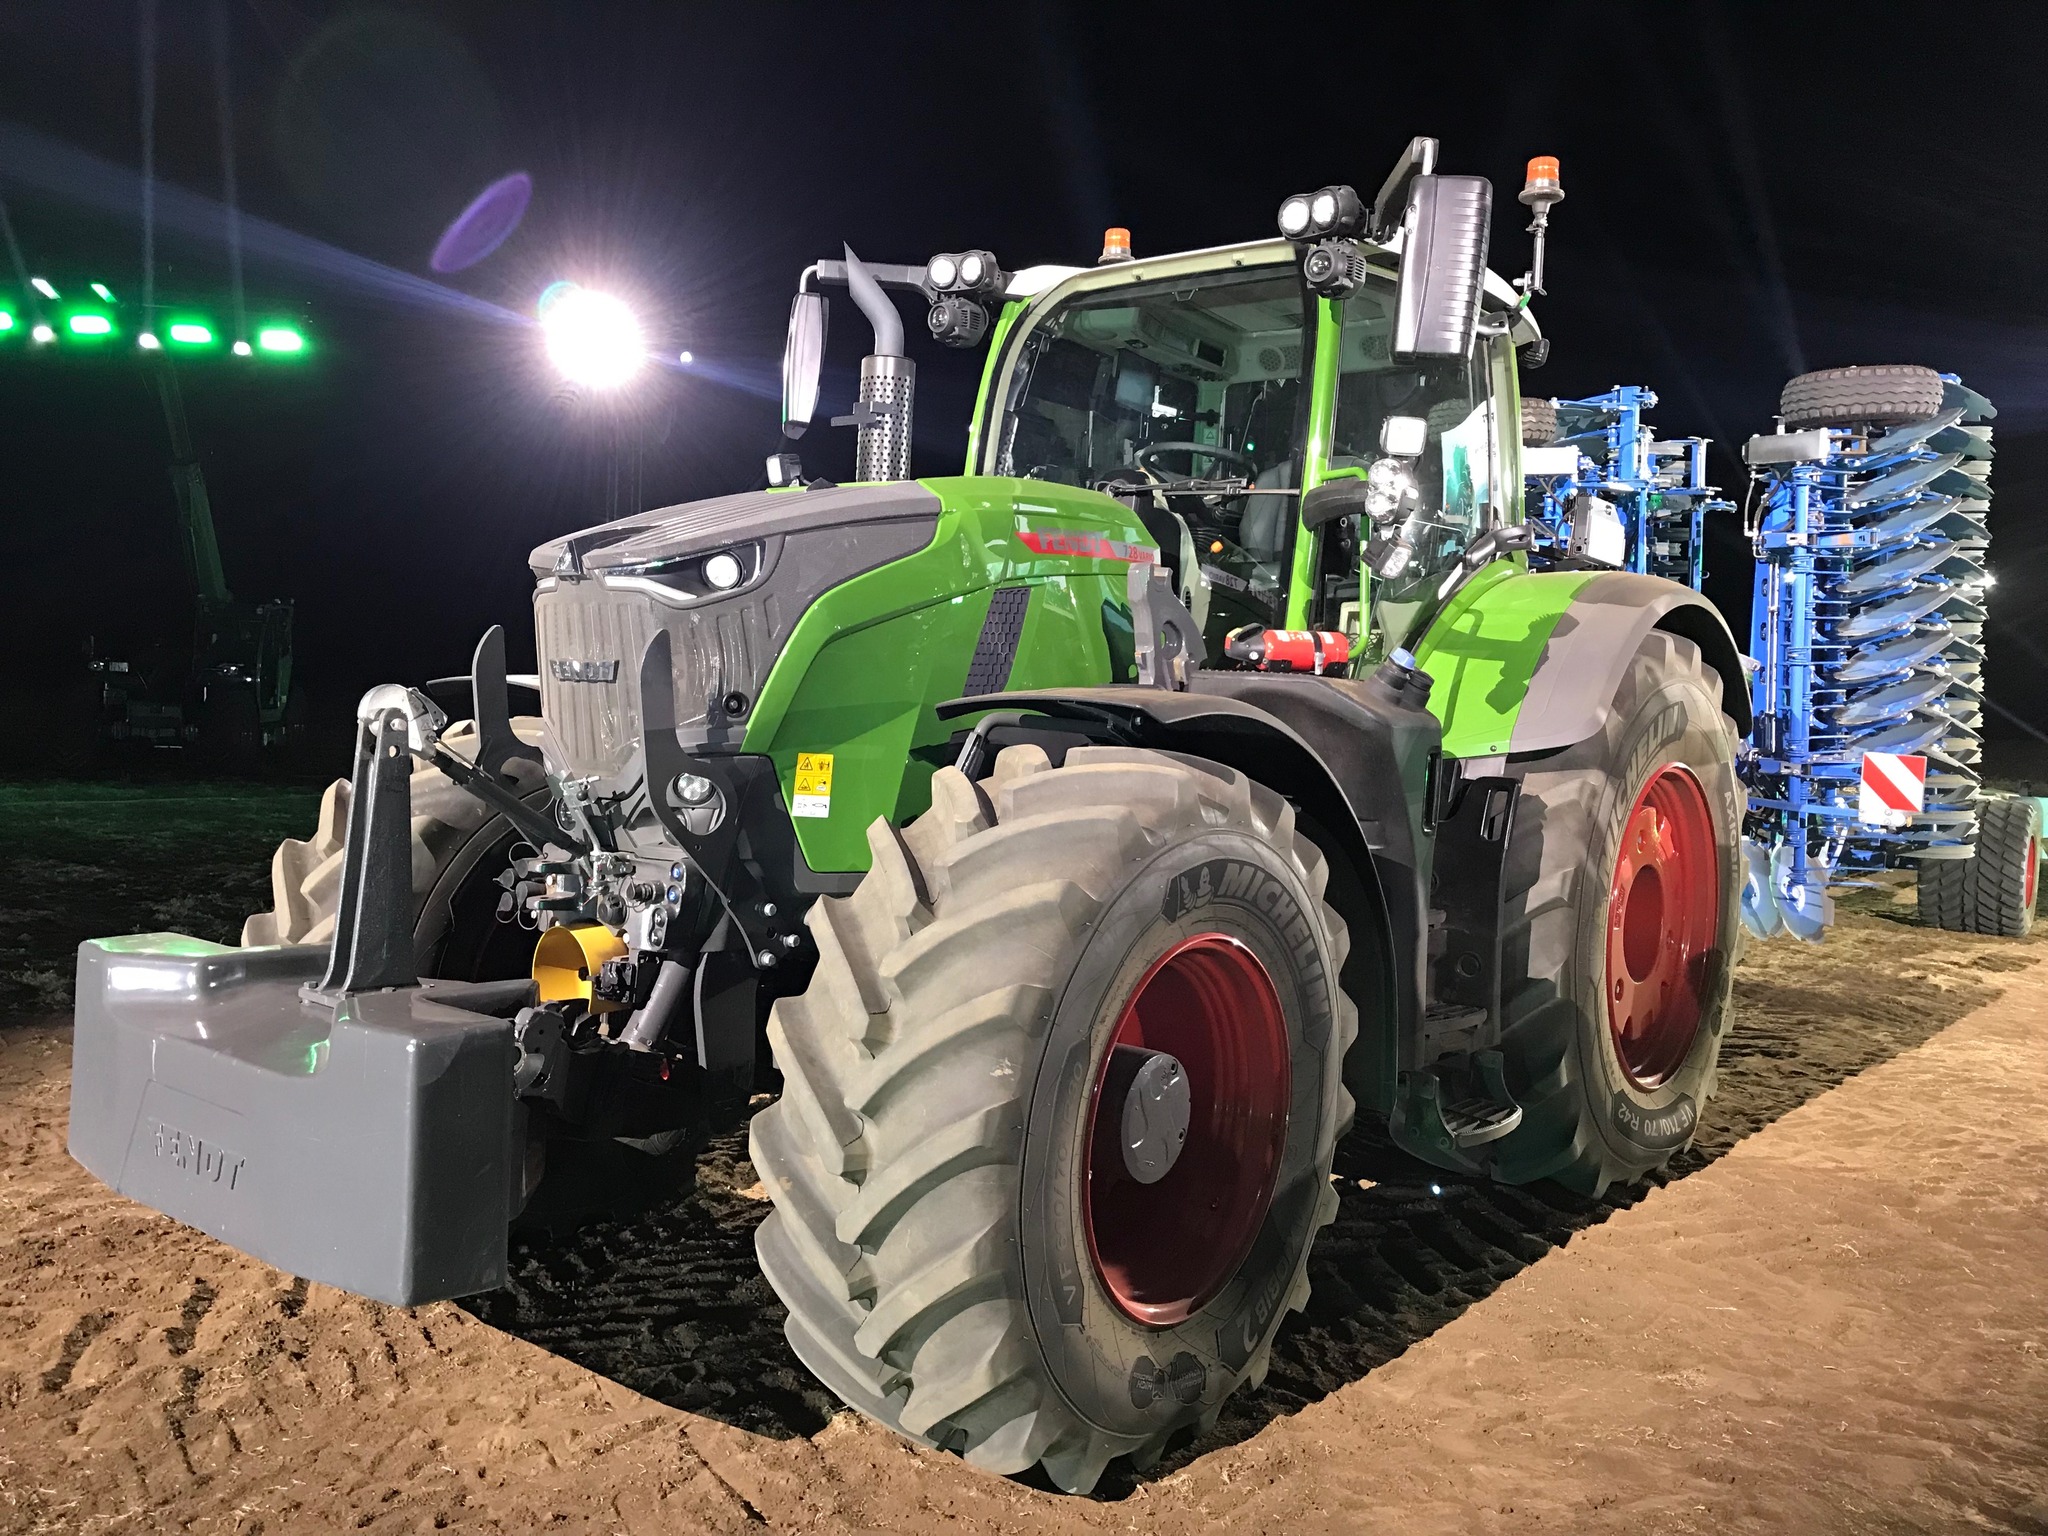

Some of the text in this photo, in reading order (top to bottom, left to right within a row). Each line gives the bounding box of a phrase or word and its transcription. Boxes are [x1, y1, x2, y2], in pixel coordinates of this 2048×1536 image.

[1037, 527, 1155, 563] FENDT 728 VARIO
[550, 660, 619, 683] FENDT
[1217, 862, 1331, 1017] MICHELIN
[1618, 1102, 1696, 1137] VF 710/70 R42
[154, 1123, 246, 1190] FENDT
[1058, 1262, 1077, 1306] VF
